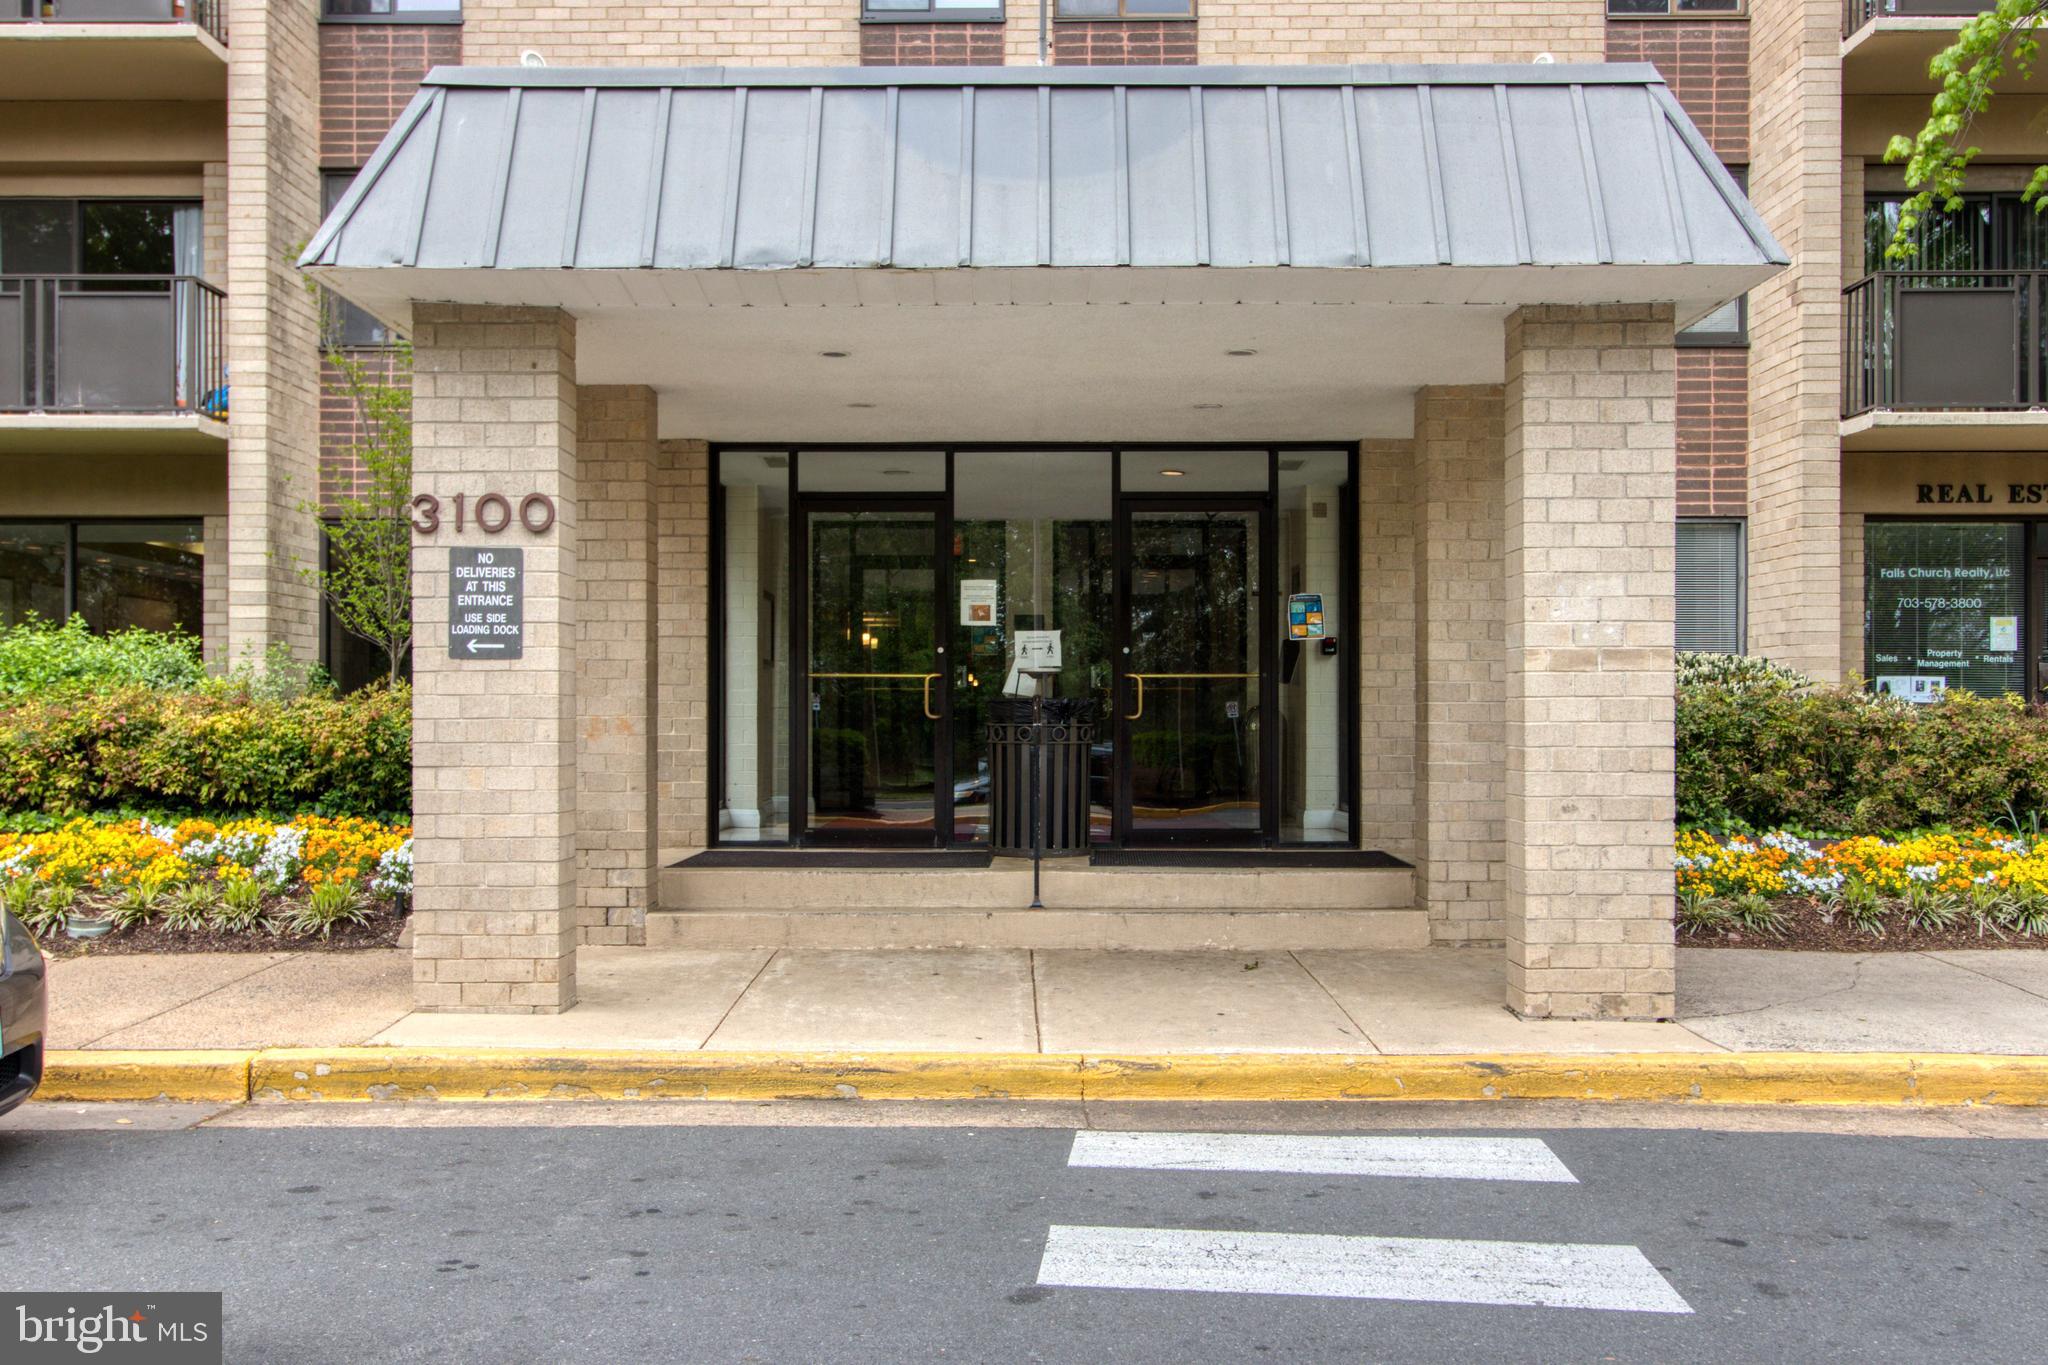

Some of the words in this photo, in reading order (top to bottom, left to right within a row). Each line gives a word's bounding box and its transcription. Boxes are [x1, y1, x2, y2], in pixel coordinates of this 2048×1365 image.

[1916, 484, 1993, 504] REAL
[412, 492, 555, 534] 3100
[477, 553, 494, 565] NO
[456, 566, 516, 579] DELIVERIES
[1880, 567, 1905, 578] Falls
[1908, 567, 1951, 578] Church
[465, 580, 478, 592] AT
[482, 580, 506, 592] THIS
[457, 594, 514, 607] ENTRANCE
[1897, 597, 1982, 609] 703-578-3800
[464, 613, 483, 623] USE
[486, 613, 507, 623] SIDE
[451, 624, 490, 635] LOADING
[493, 624, 519, 635] DOCK
[1875, 653, 1898, 663] Sales
[1927, 649, 1963, 659] Property
[1983, 654, 2014, 663] Rentals
[1917, 659, 1970, 668] Management
